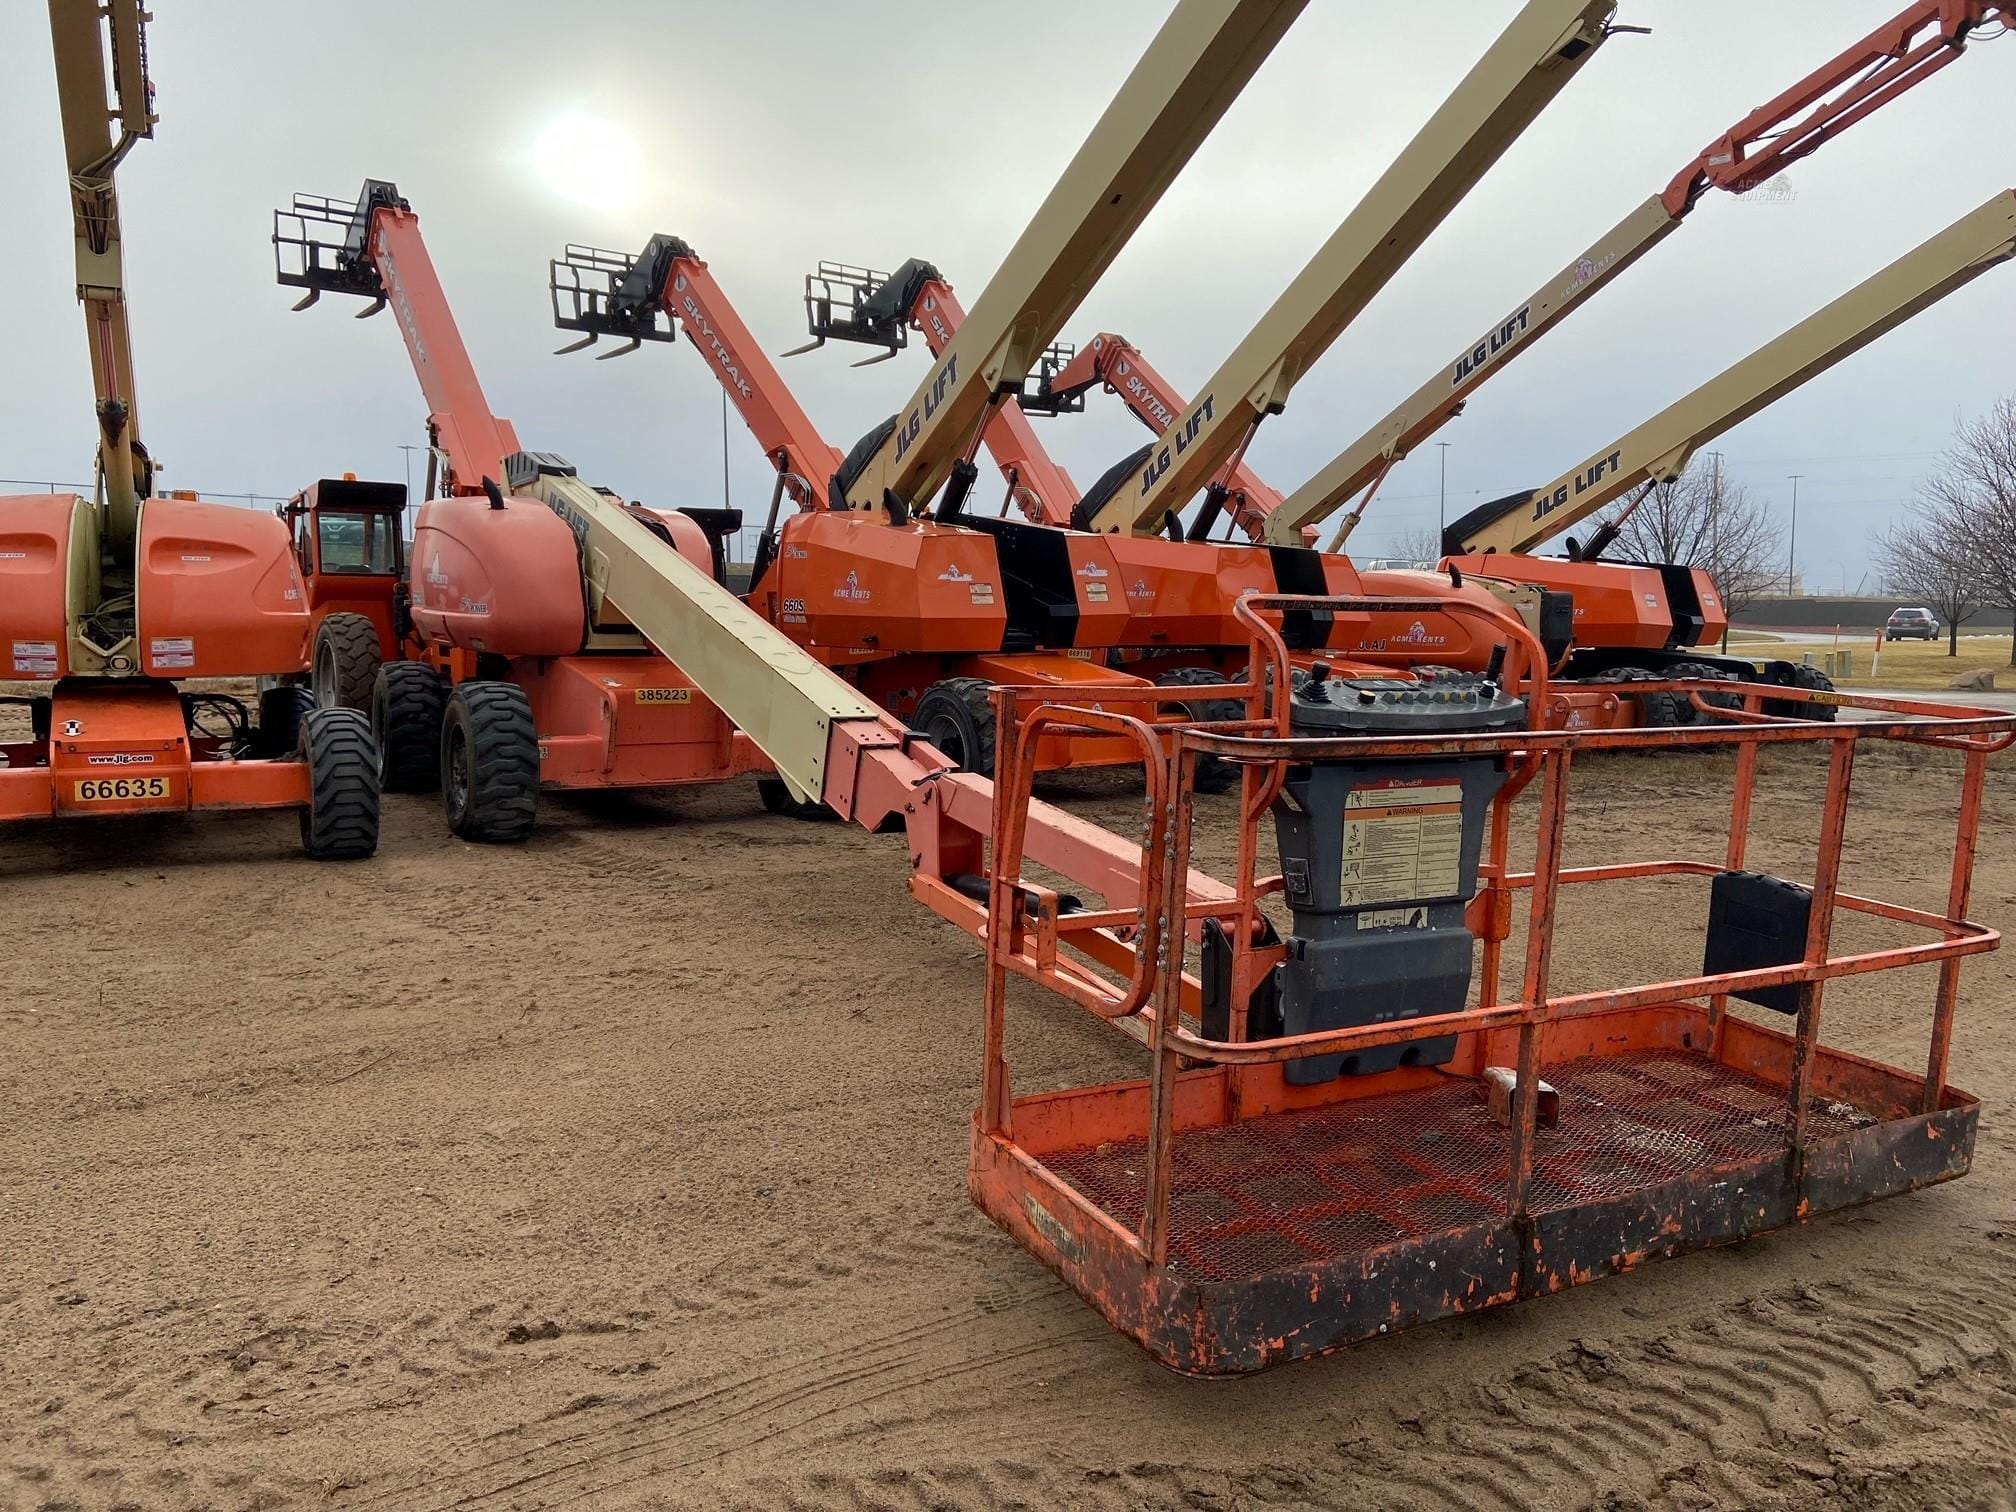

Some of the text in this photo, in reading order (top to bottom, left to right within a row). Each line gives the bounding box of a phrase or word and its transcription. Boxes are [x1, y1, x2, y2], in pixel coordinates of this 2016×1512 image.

[1560, 252, 1617, 299] ACME RENTS
[682, 295, 752, 400] SKYTRAK
[1452, 306, 1530, 386] JLG LIFT
[895, 352, 958, 464] JLG LIFT
[1141, 393, 1214, 496] JLG LIFT
[1532, 450, 1621, 522] JLG LIFT
[833, 587, 871, 599] ACME RENTS
[783, 599, 804, 612] 660S
[1391, 635, 1445, 643] ACME RENTS
[638, 689, 688, 700] 385223
[90, 755, 152, 763] www.jlg.com
[81, 778, 163, 799] 66635
[1392, 807, 1423, 816] WARNING
